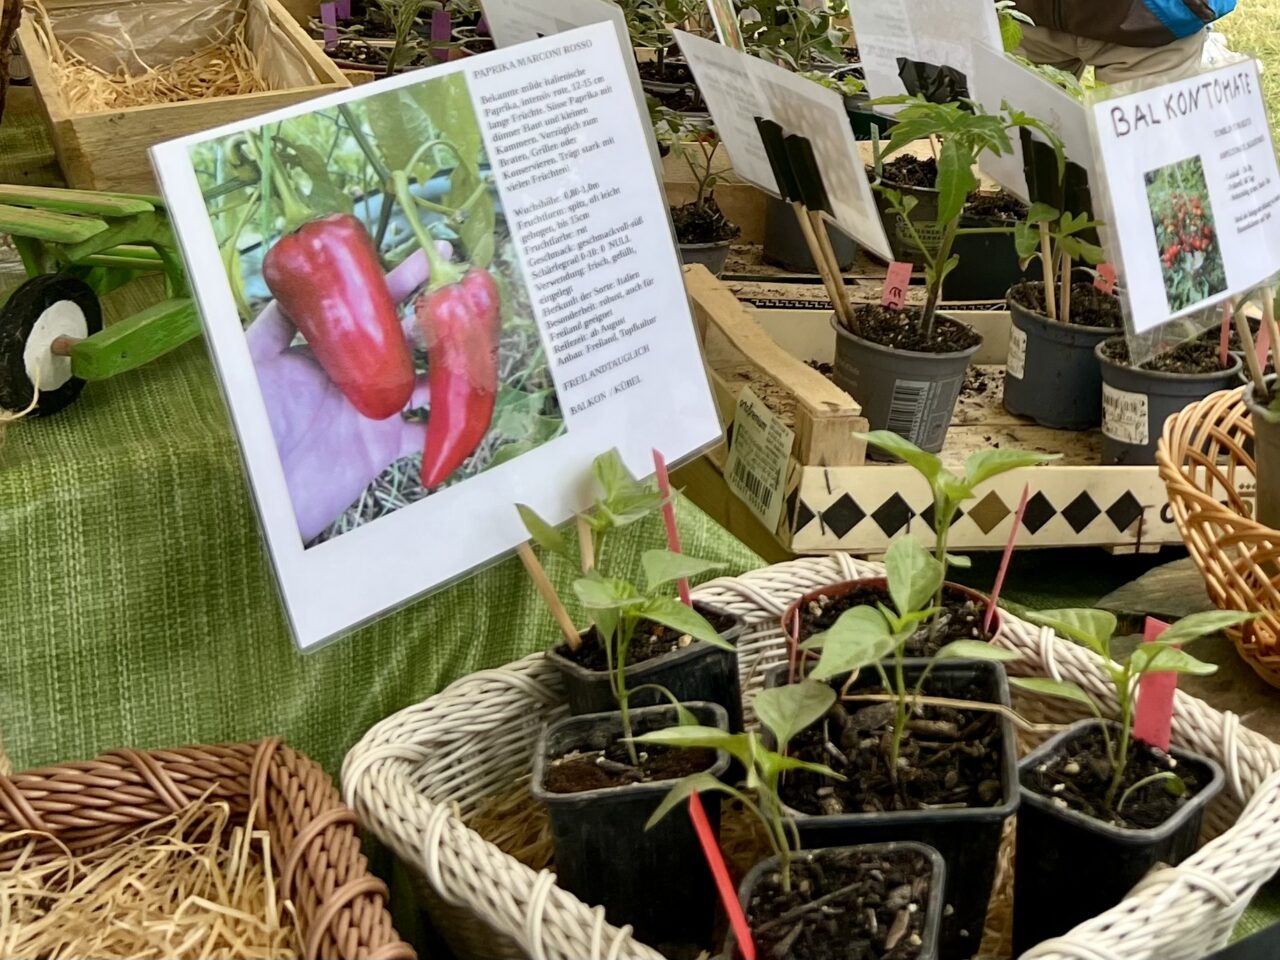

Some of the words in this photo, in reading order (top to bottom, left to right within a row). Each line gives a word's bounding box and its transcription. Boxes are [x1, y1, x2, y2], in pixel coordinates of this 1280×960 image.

[473, 61, 517, 79] PAPRIKA
[516, 48, 562, 67] MARCONI
[563, 40, 593, 54] ROSSO
[480, 89, 520, 104] Bekannte
[521, 80, 543, 93] milde
[544, 68, 587, 86] italienische
[521, 91, 552, 106] intensiv
[571, 78, 593, 91] 12-15
[593, 76, 606, 84] cm
[488, 118, 510, 130] lange
[546, 101, 568, 112] Süsse
[568, 91, 599, 105] Paprika
[600, 86, 613, 96] mit
[492, 128, 521, 142] dünner
[544, 114, 561, 126] und
[560, 107, 589, 121] kleinen
[539, 121, 582, 140] Vorzüglich
[582, 117, 599, 127] zum
[530, 144, 560, 157] Grillen
[560, 137, 577, 147] oder
[558, 149, 581, 161] Trägt
[581, 141, 601, 153] stark
[602, 137, 616, 147] mit
[507, 180, 532, 192] vielen
[589, 195, 601, 204] oft
[600, 187, 622, 200] leicht
[556, 219, 570, 229] bis
[570, 213, 591, 224] 15cm
[576, 226, 589, 236] rot
[608, 235, 632, 250] NULL
[539, 286, 574, 304] eingelegt
[542, 296, 580, 317] Herkunft
[580, 292, 593, 302] der
[616, 272, 641, 286] Italien
[626, 283, 643, 296] auch
[643, 278, 655, 288] für
[549, 321, 583, 342] Freiland
[584, 309, 614, 329] geeignet
[590, 328, 601, 338] ab
[601, 317, 627, 333] August
[619, 316, 657, 337] Topfkultur
[563, 344, 651, 391] FREILANDTAUGLICH
[570, 392, 607, 416] BALKON
[614, 375, 642, 394] KÜBEL
